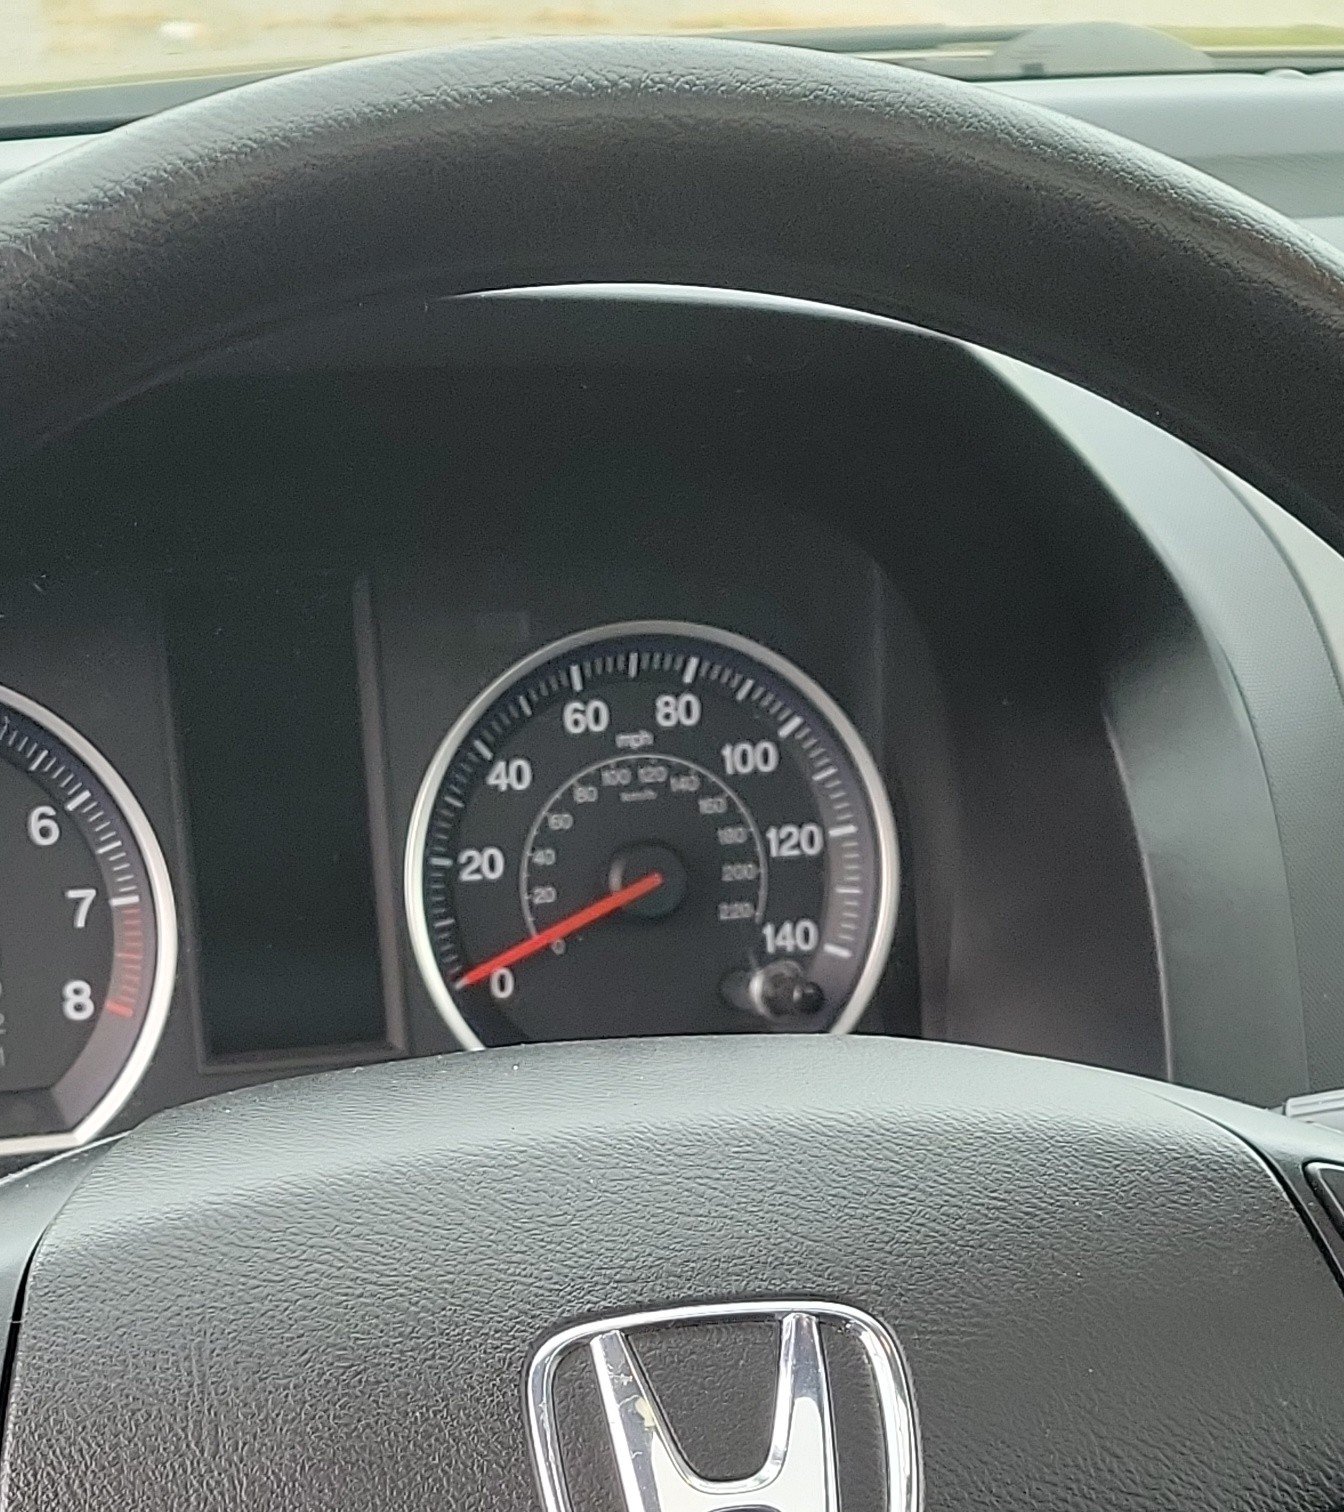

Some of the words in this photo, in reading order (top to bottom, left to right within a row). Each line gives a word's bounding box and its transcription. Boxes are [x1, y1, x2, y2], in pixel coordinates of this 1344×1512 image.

[562, 700, 609, 735] 60
[656, 693, 702, 728] 80
[721, 739, 778, 775] 100
[485, 758, 532, 792] 40
[28, 805, 60, 847] 6
[765, 824, 822, 857] 120
[458, 847, 504, 882] 20
[64, 888, 99, 928] 7
[762, 919, 818, 955] 140
[61, 980, 96, 1021] 8
[489, 968, 515, 999] 0
